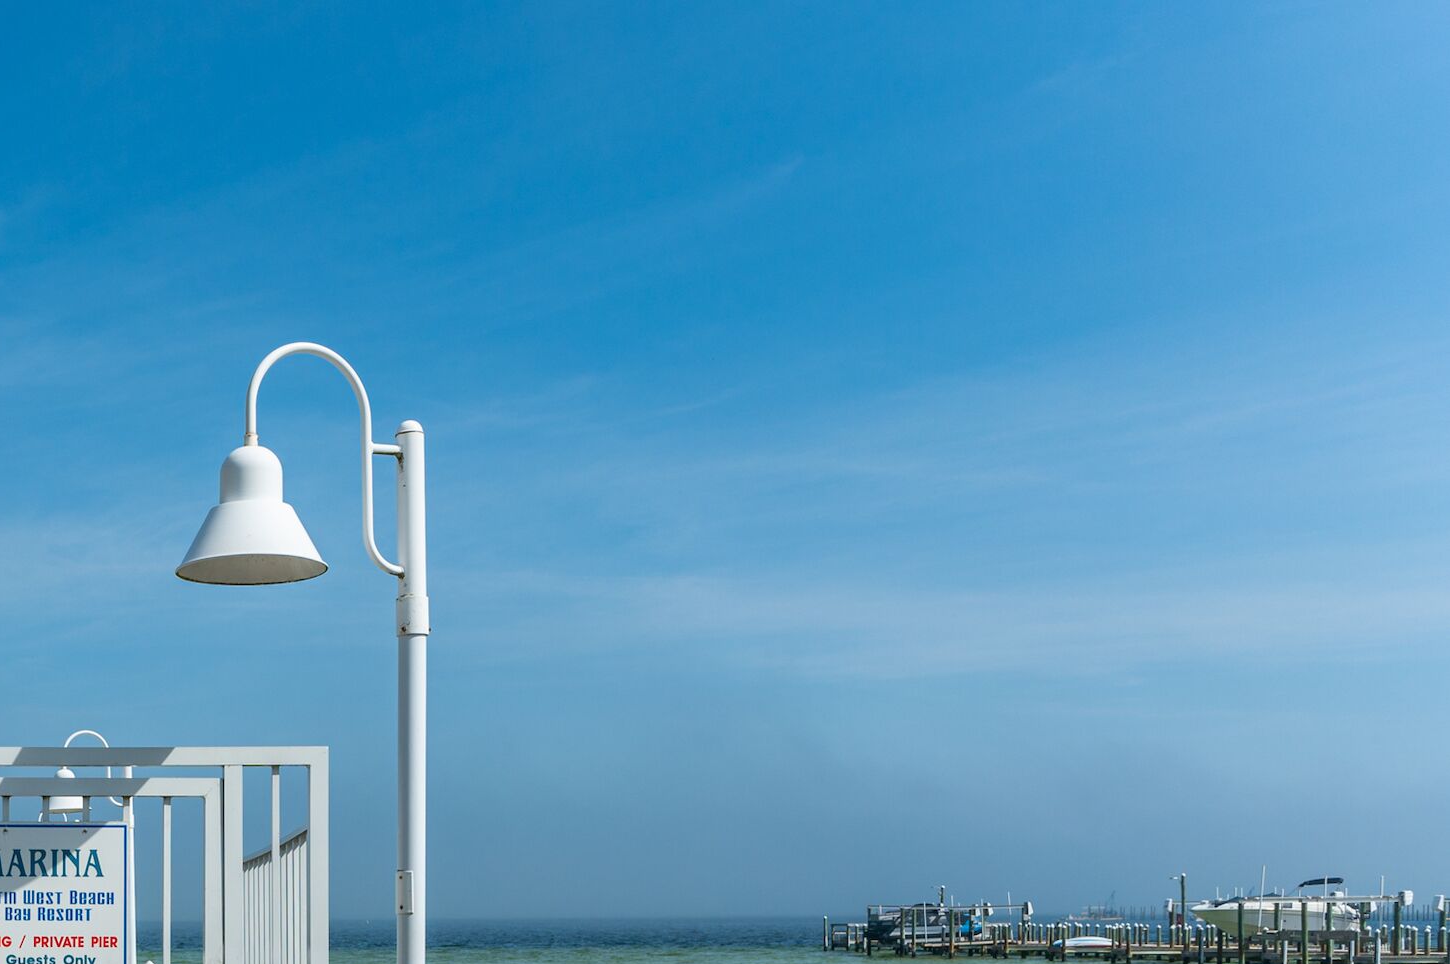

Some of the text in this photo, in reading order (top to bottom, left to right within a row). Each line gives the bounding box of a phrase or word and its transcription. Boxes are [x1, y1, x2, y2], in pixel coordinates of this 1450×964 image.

[19, 935, 26, 948] /
[34, 936, 84, 948] PRIVATE
[91, 936, 118, 948] PIER
